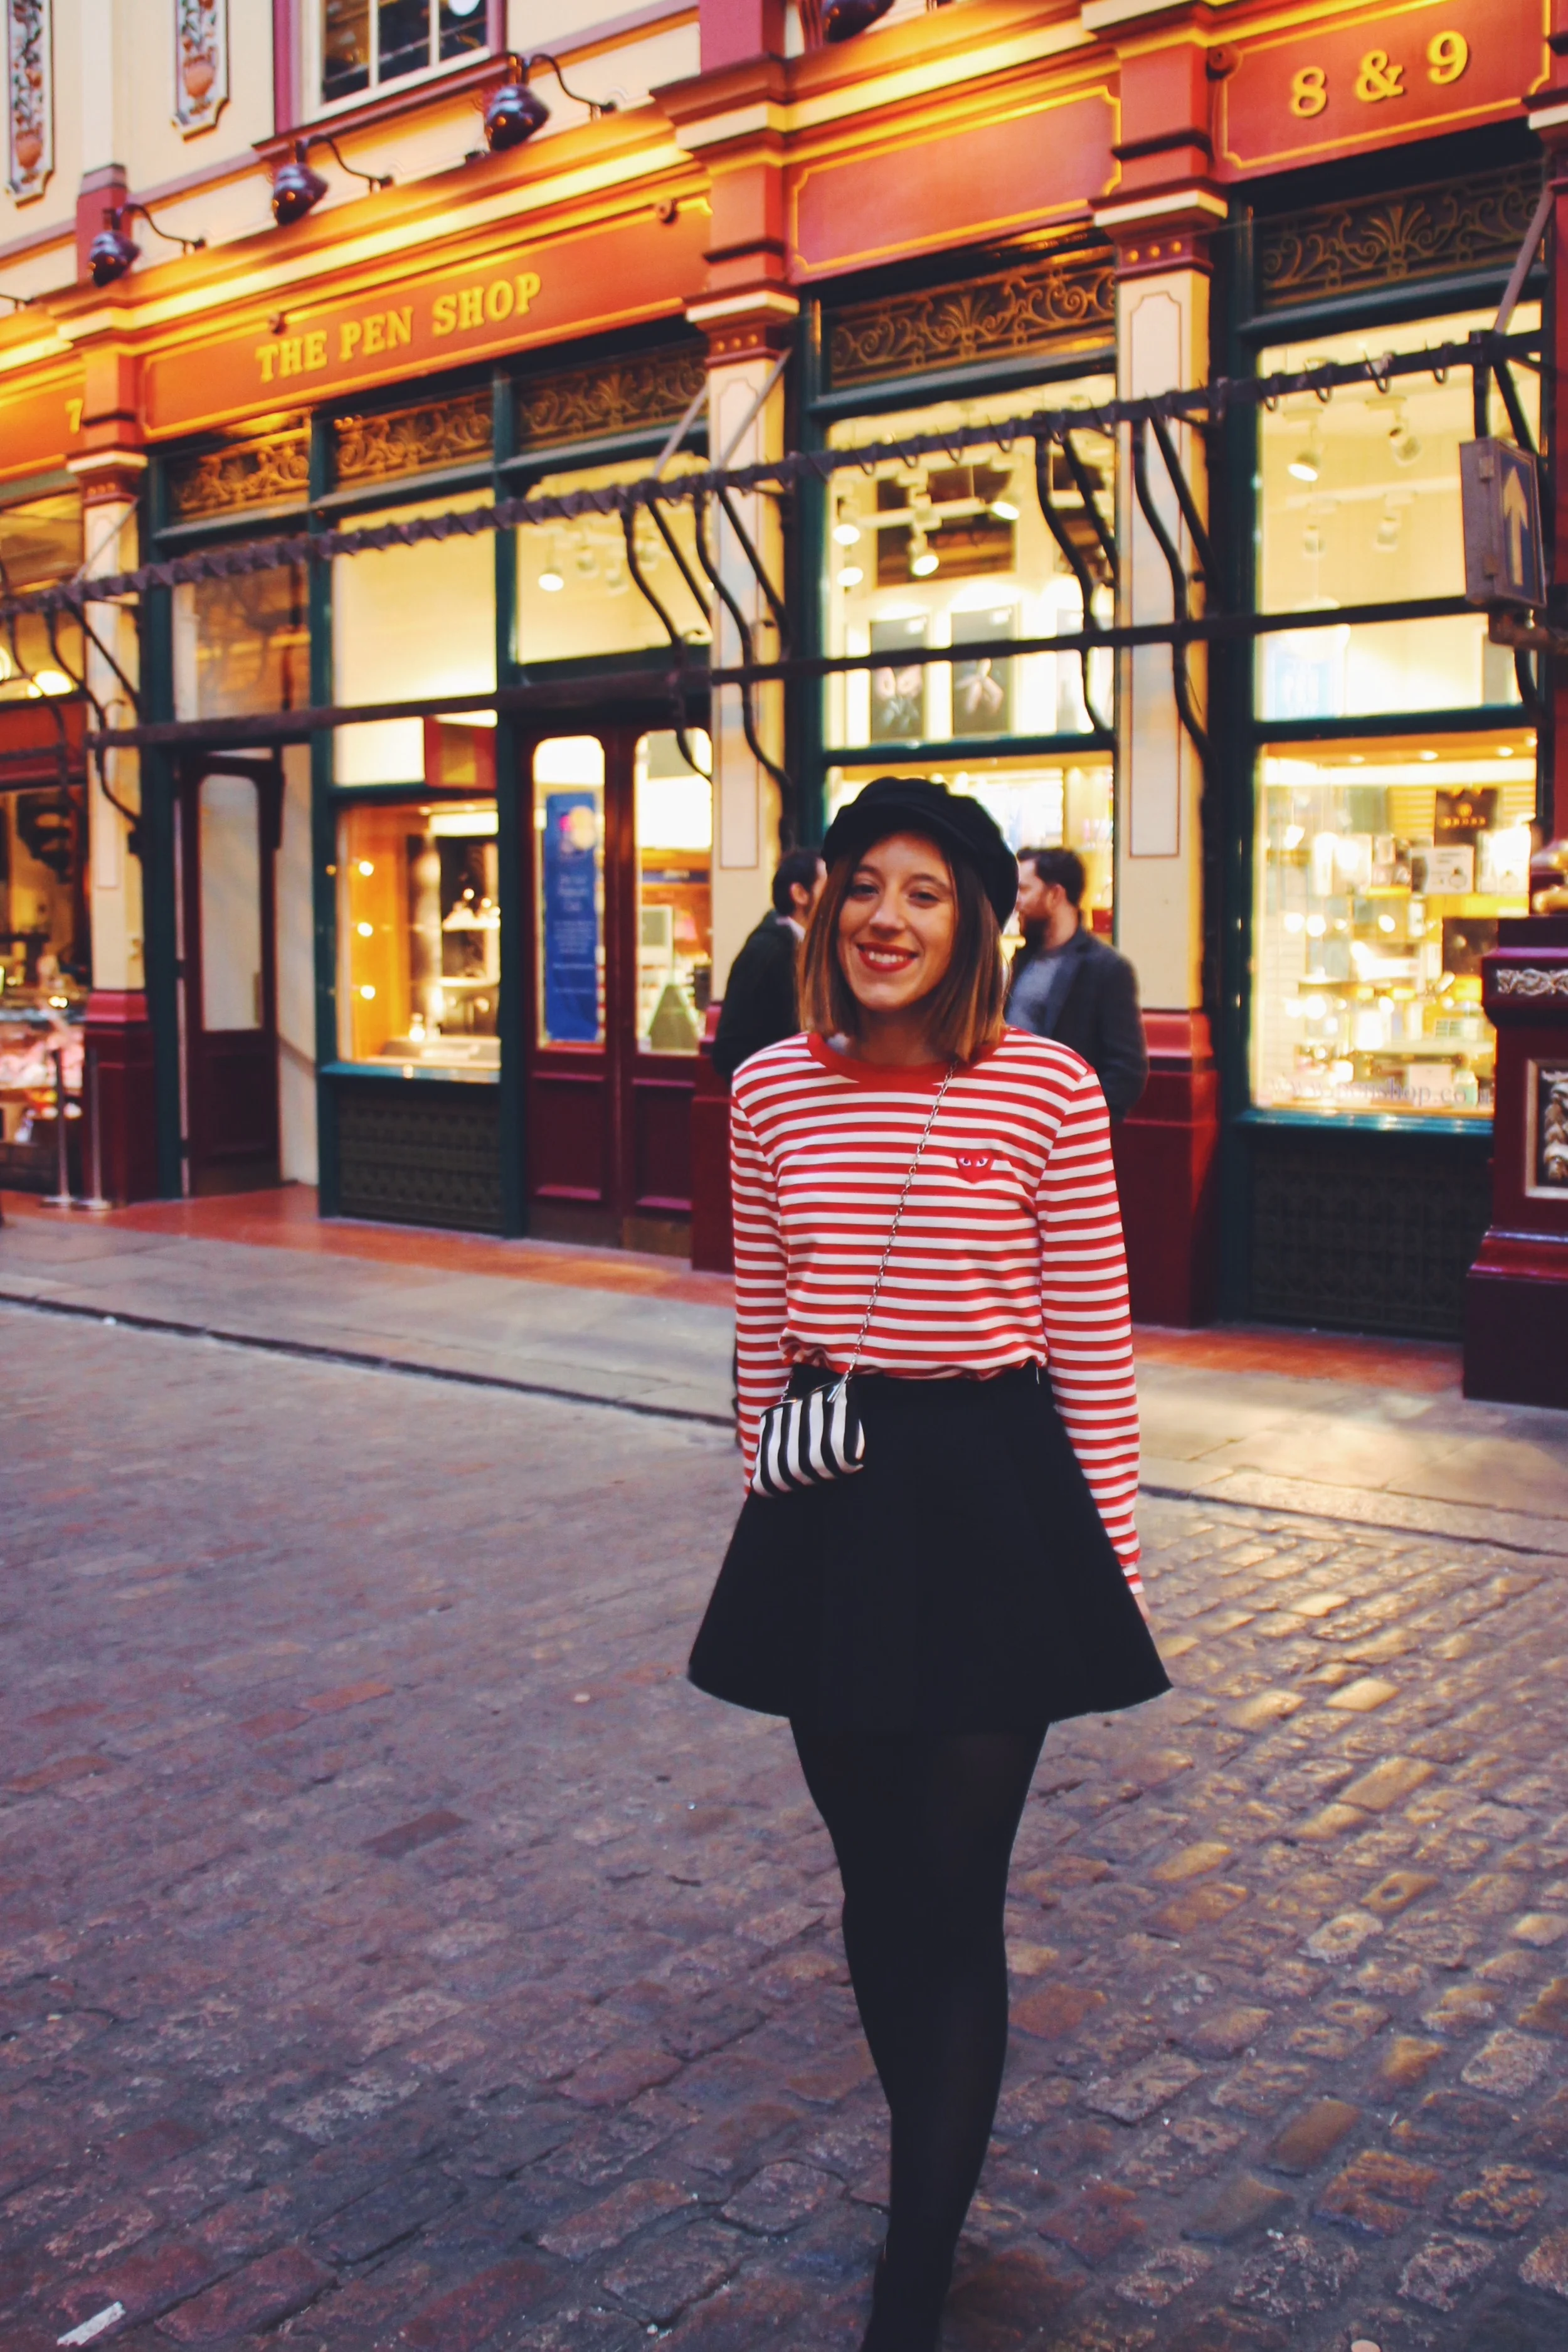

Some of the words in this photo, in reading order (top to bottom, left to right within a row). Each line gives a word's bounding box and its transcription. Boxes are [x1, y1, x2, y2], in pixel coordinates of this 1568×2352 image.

[1291, 66, 1327, 117] 8
[1355, 49, 1405, 102] &
[1426, 29, 1468, 85] 9
[255, 329, 328, 383] THE
[339, 305, 414, 362] PEN
[432, 272, 541, 337] SHOP
[65, 397, 84, 435] 7
